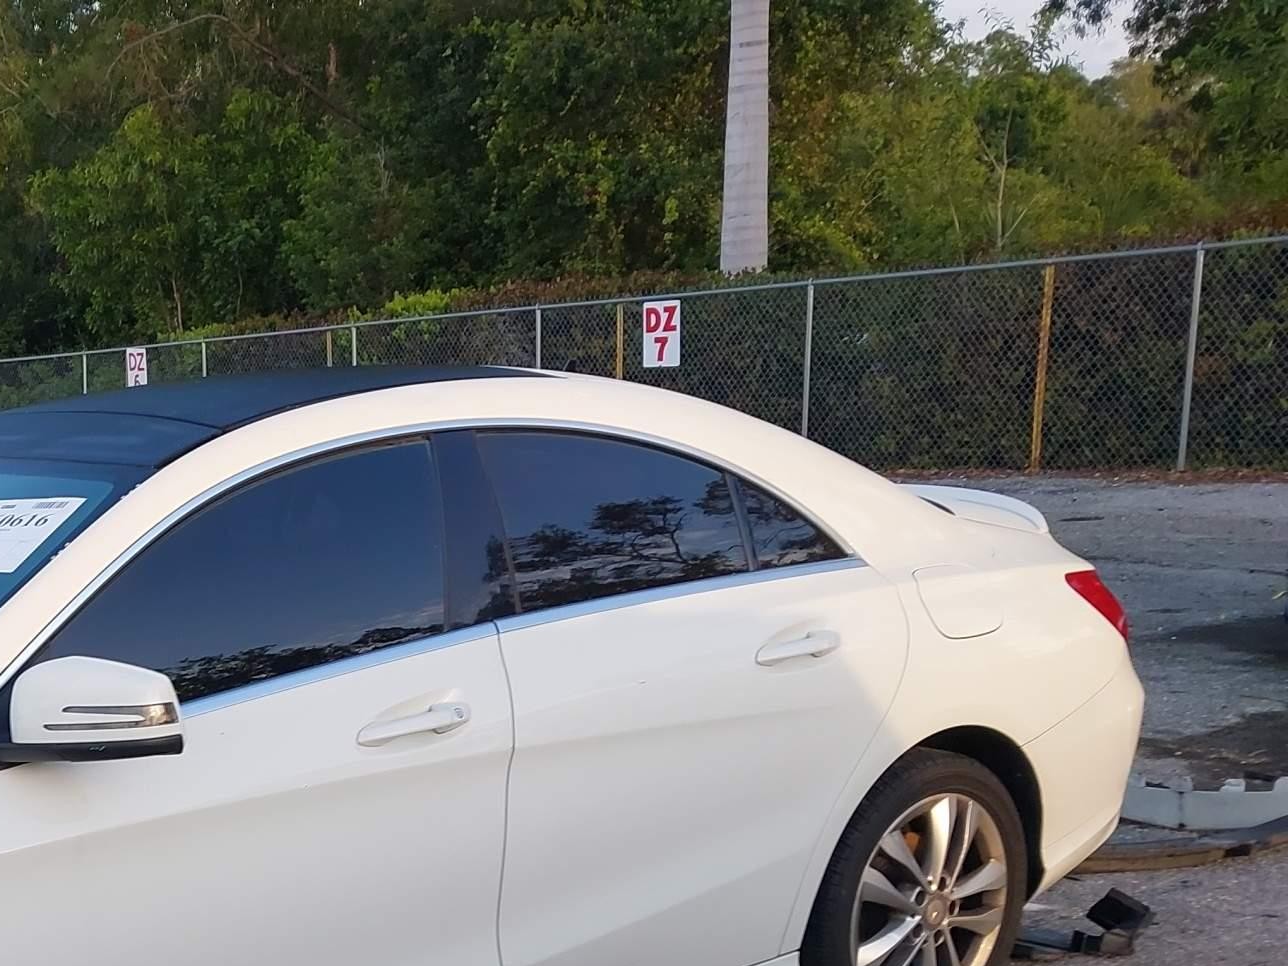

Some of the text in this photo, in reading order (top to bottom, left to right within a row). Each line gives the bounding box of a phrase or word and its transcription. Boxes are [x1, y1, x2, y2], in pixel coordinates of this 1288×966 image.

[646, 305, 678, 333] DZ
[128, 352, 145, 372] DZ
[654, 336, 669, 362] 7
